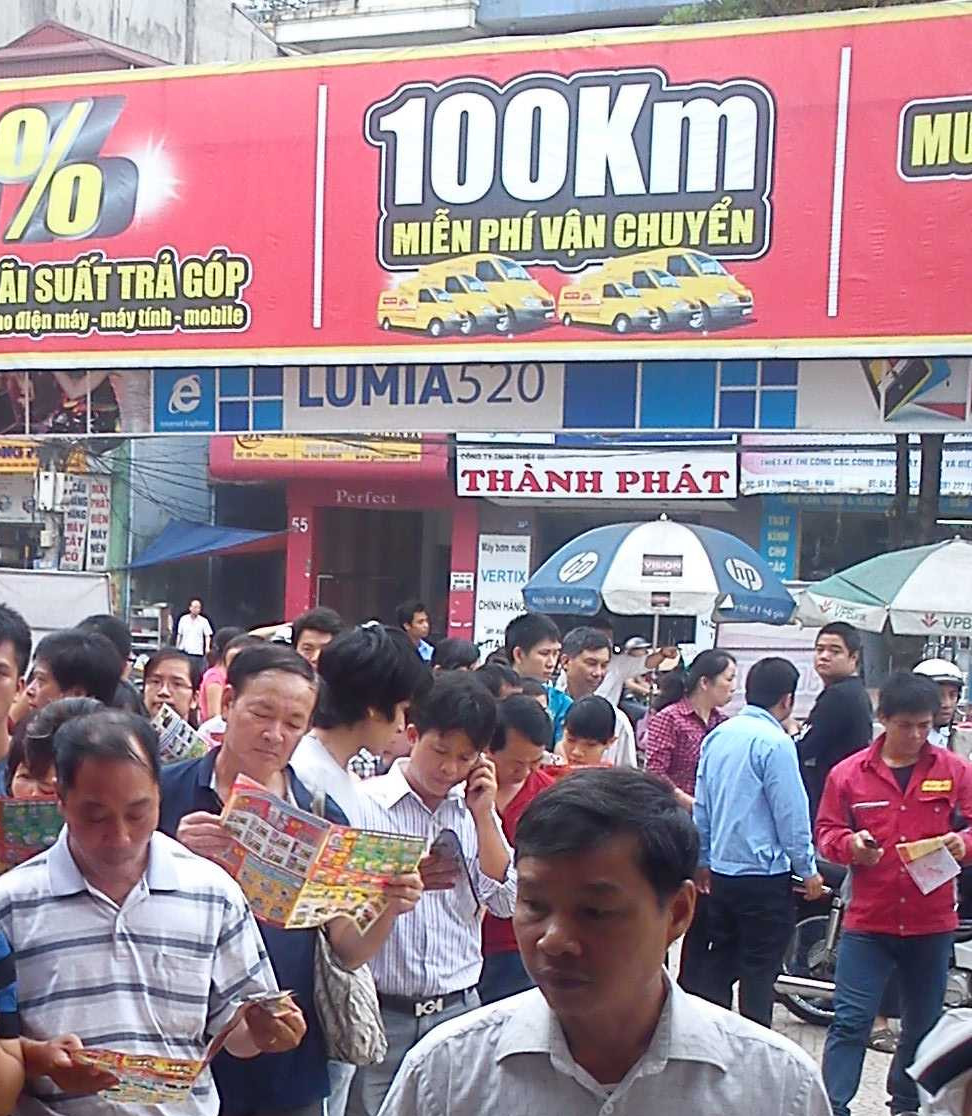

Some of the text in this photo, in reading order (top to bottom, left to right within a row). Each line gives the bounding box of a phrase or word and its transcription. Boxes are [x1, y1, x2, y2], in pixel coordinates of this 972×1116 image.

[378, 83, 756, 205] 100Km
[392, 198, 755, 256] MIỄN PHÍ VẬN CHUYỂN
[34, 257, 112, 303] SUẤT
[117, 253, 177, 301] TRẢ
[182, 253, 246, 299] GÓP
[15, 310, 52, 334] điện
[55, 309, 89, 331] máy
[101, 307, 136, 330] máy
[138, 307, 172, 328] tính
[184, 306, 244, 327] mobile
[461, 463, 730, 493] THÀNH PHÁT
[336, 488, 397, 504] Perfect
[291, 517, 309, 532] 55
[481, 569, 527, 583] VERTIX
[729, 558, 760, 591] hp
